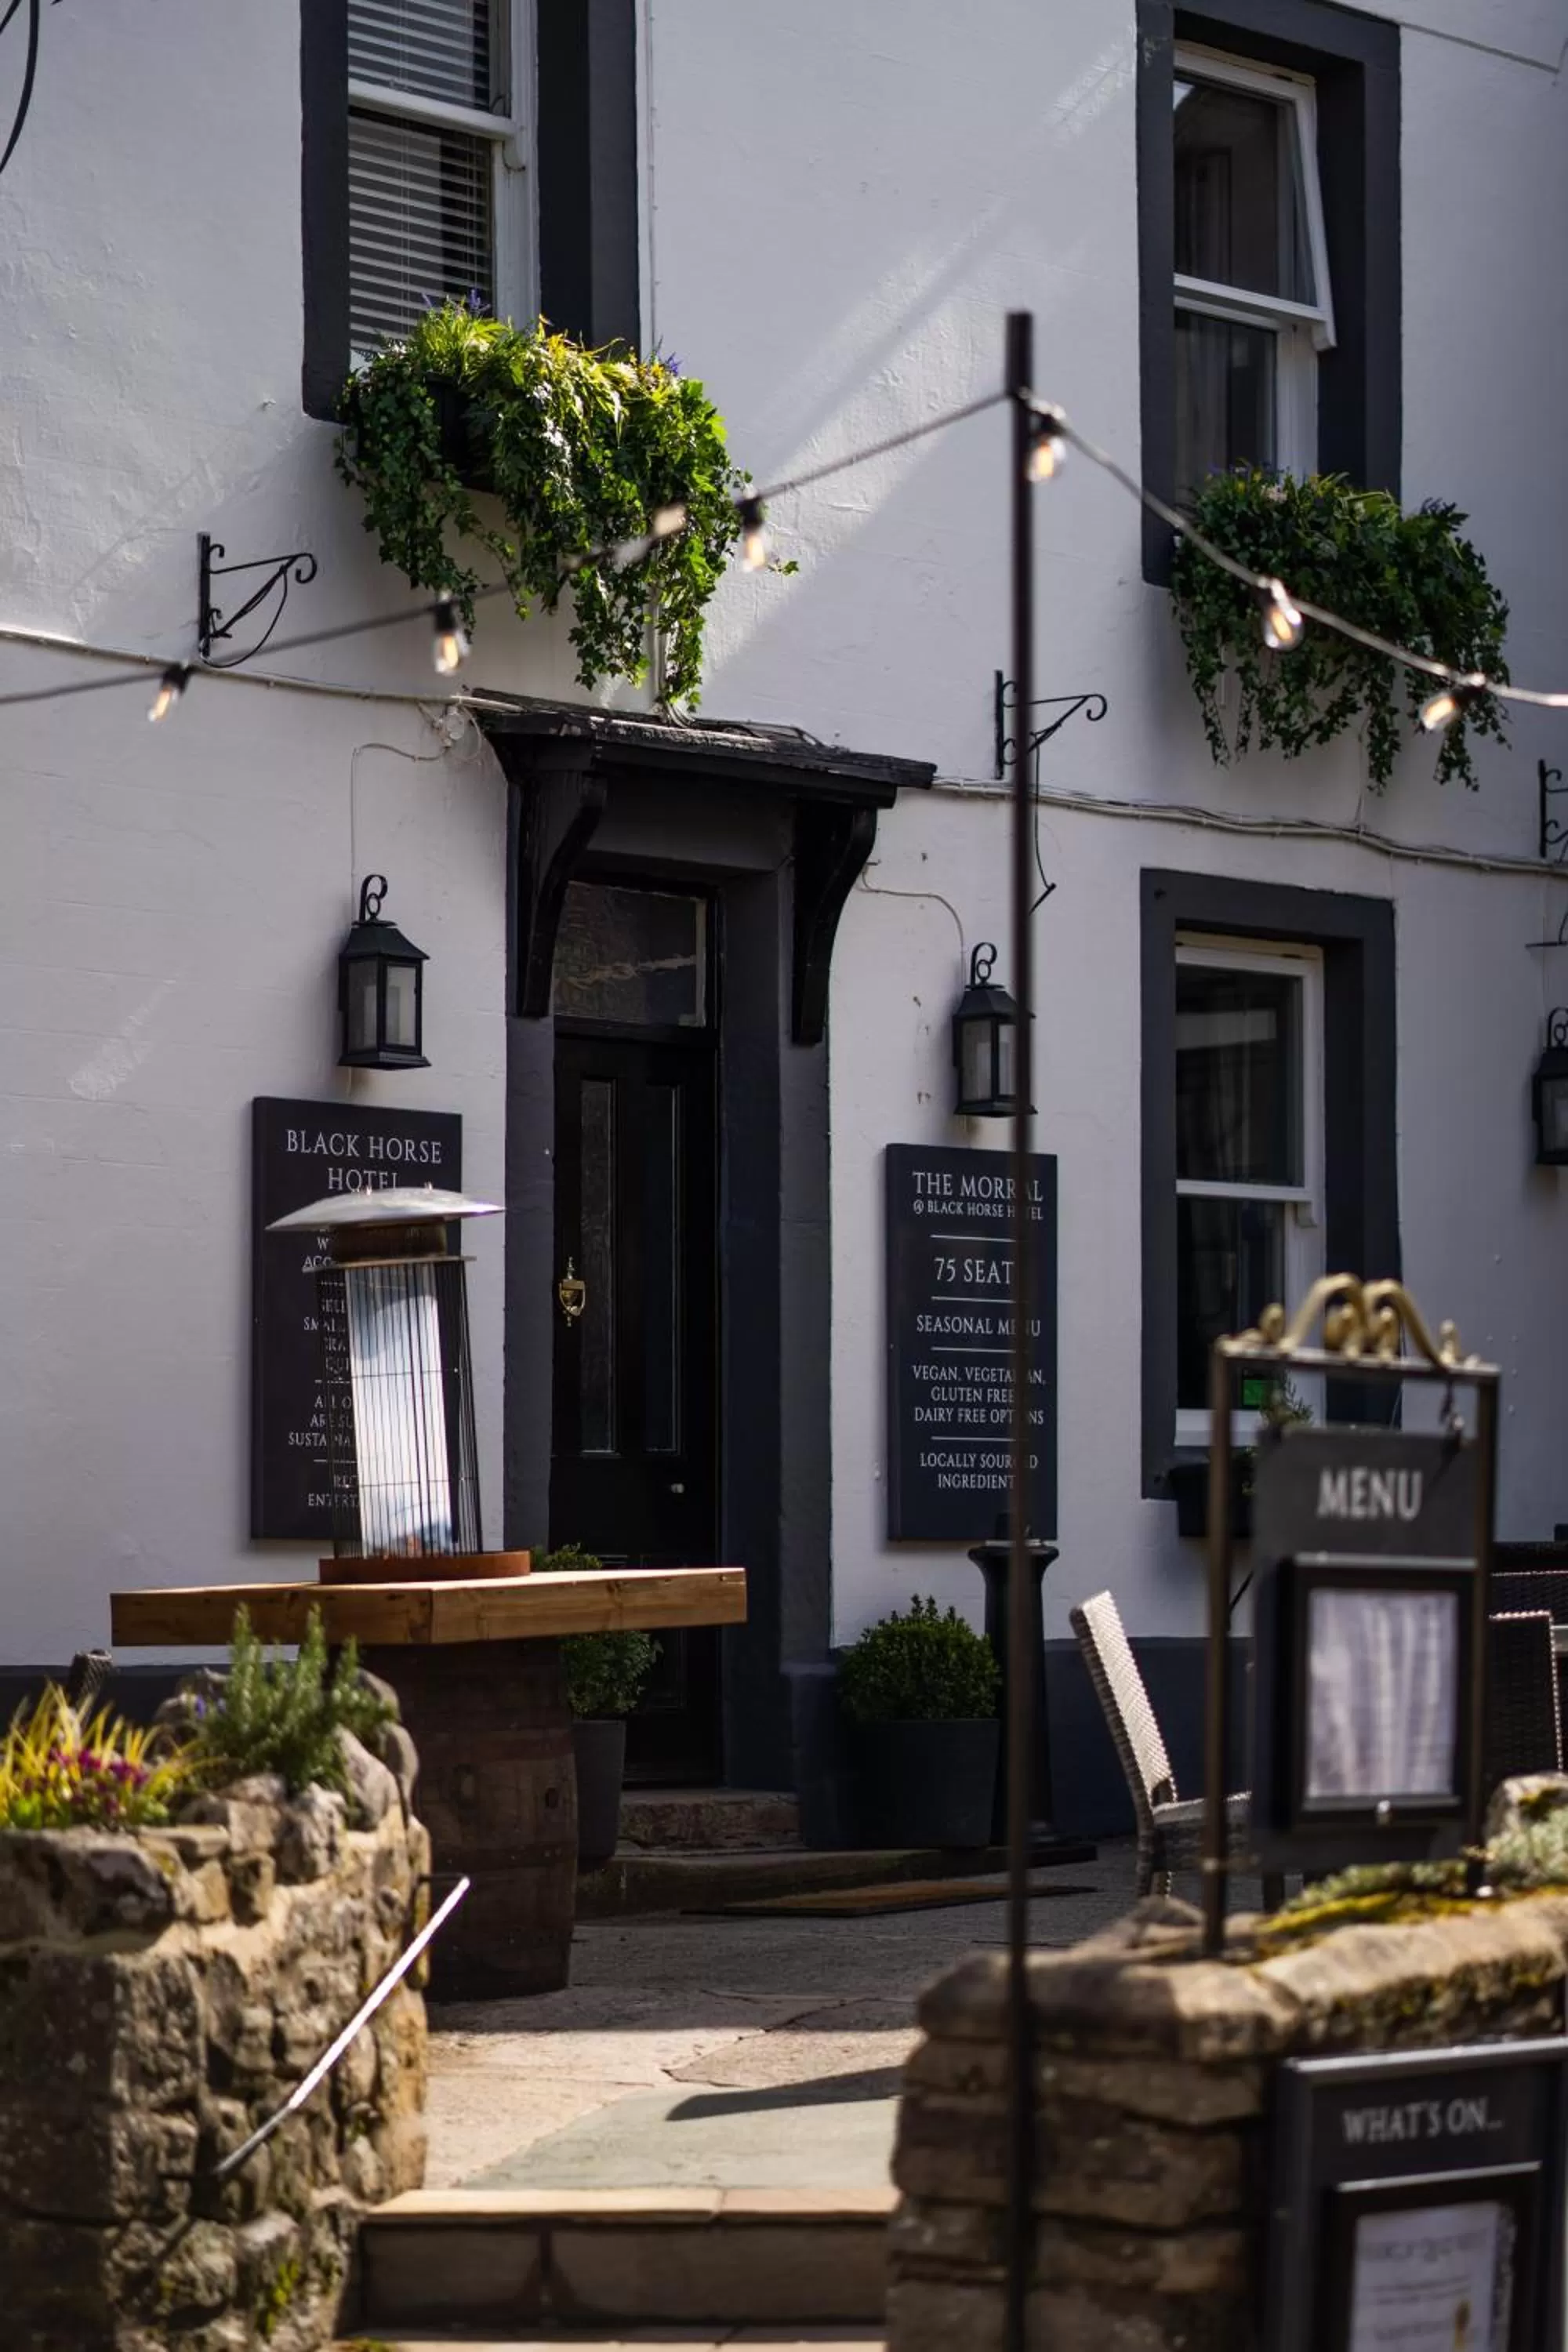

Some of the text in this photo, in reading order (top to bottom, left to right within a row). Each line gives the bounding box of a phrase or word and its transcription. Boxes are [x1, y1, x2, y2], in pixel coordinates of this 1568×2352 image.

[286, 1129, 442, 1163] BLACK HORSE
[913, 1172, 953, 1196] THE
[927, 1200, 964, 1214] BLACK
[967, 1203, 1004, 1218] HORSE
[1007, 1205, 1044, 1221] HEL
[934, 1257, 956, 1282] 75
[916, 1314, 993, 1334] SEASONAL
[931, 1386, 983, 1403] GLUTEN
[915, 1407, 1044, 1425] DAIRY FREE OPTNS
[920, 1453, 976, 1468] LOCALLY
[1317, 1467, 1422, 1521] MENU
[1342, 2101, 1441, 2143] WHAT'S
